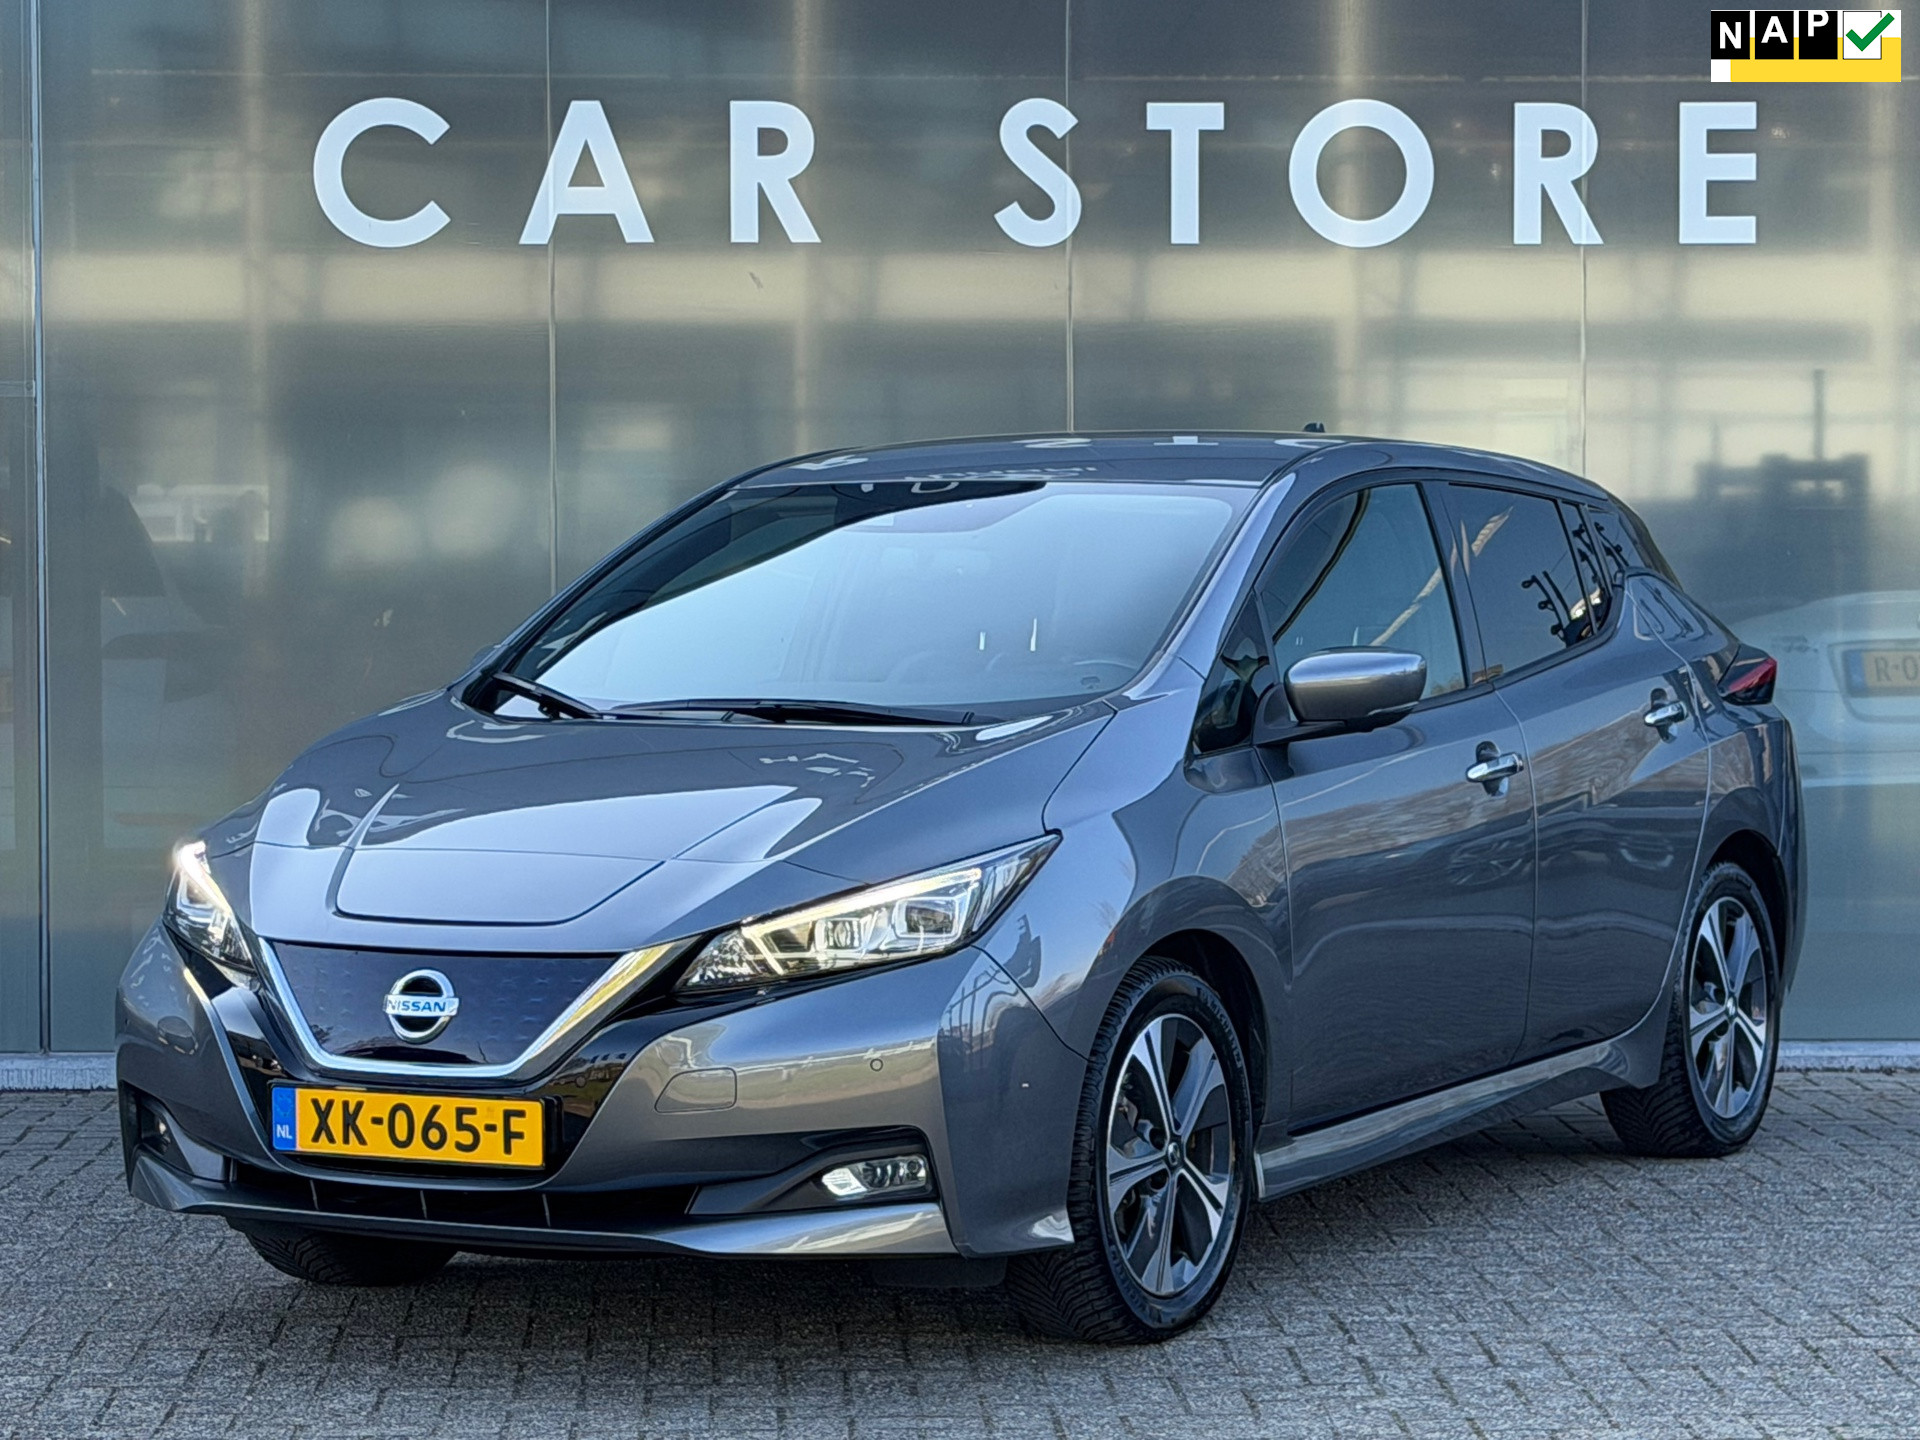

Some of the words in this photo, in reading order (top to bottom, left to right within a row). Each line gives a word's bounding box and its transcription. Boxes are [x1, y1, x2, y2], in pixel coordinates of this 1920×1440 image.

[313, 97, 821, 247] CAR
[994, 98, 1757, 247] STORE
[388, 999, 446, 1012] NISSAN
[276, 1124, 293, 1139] NL
[310, 1098, 526, 1155] XK-065-F
